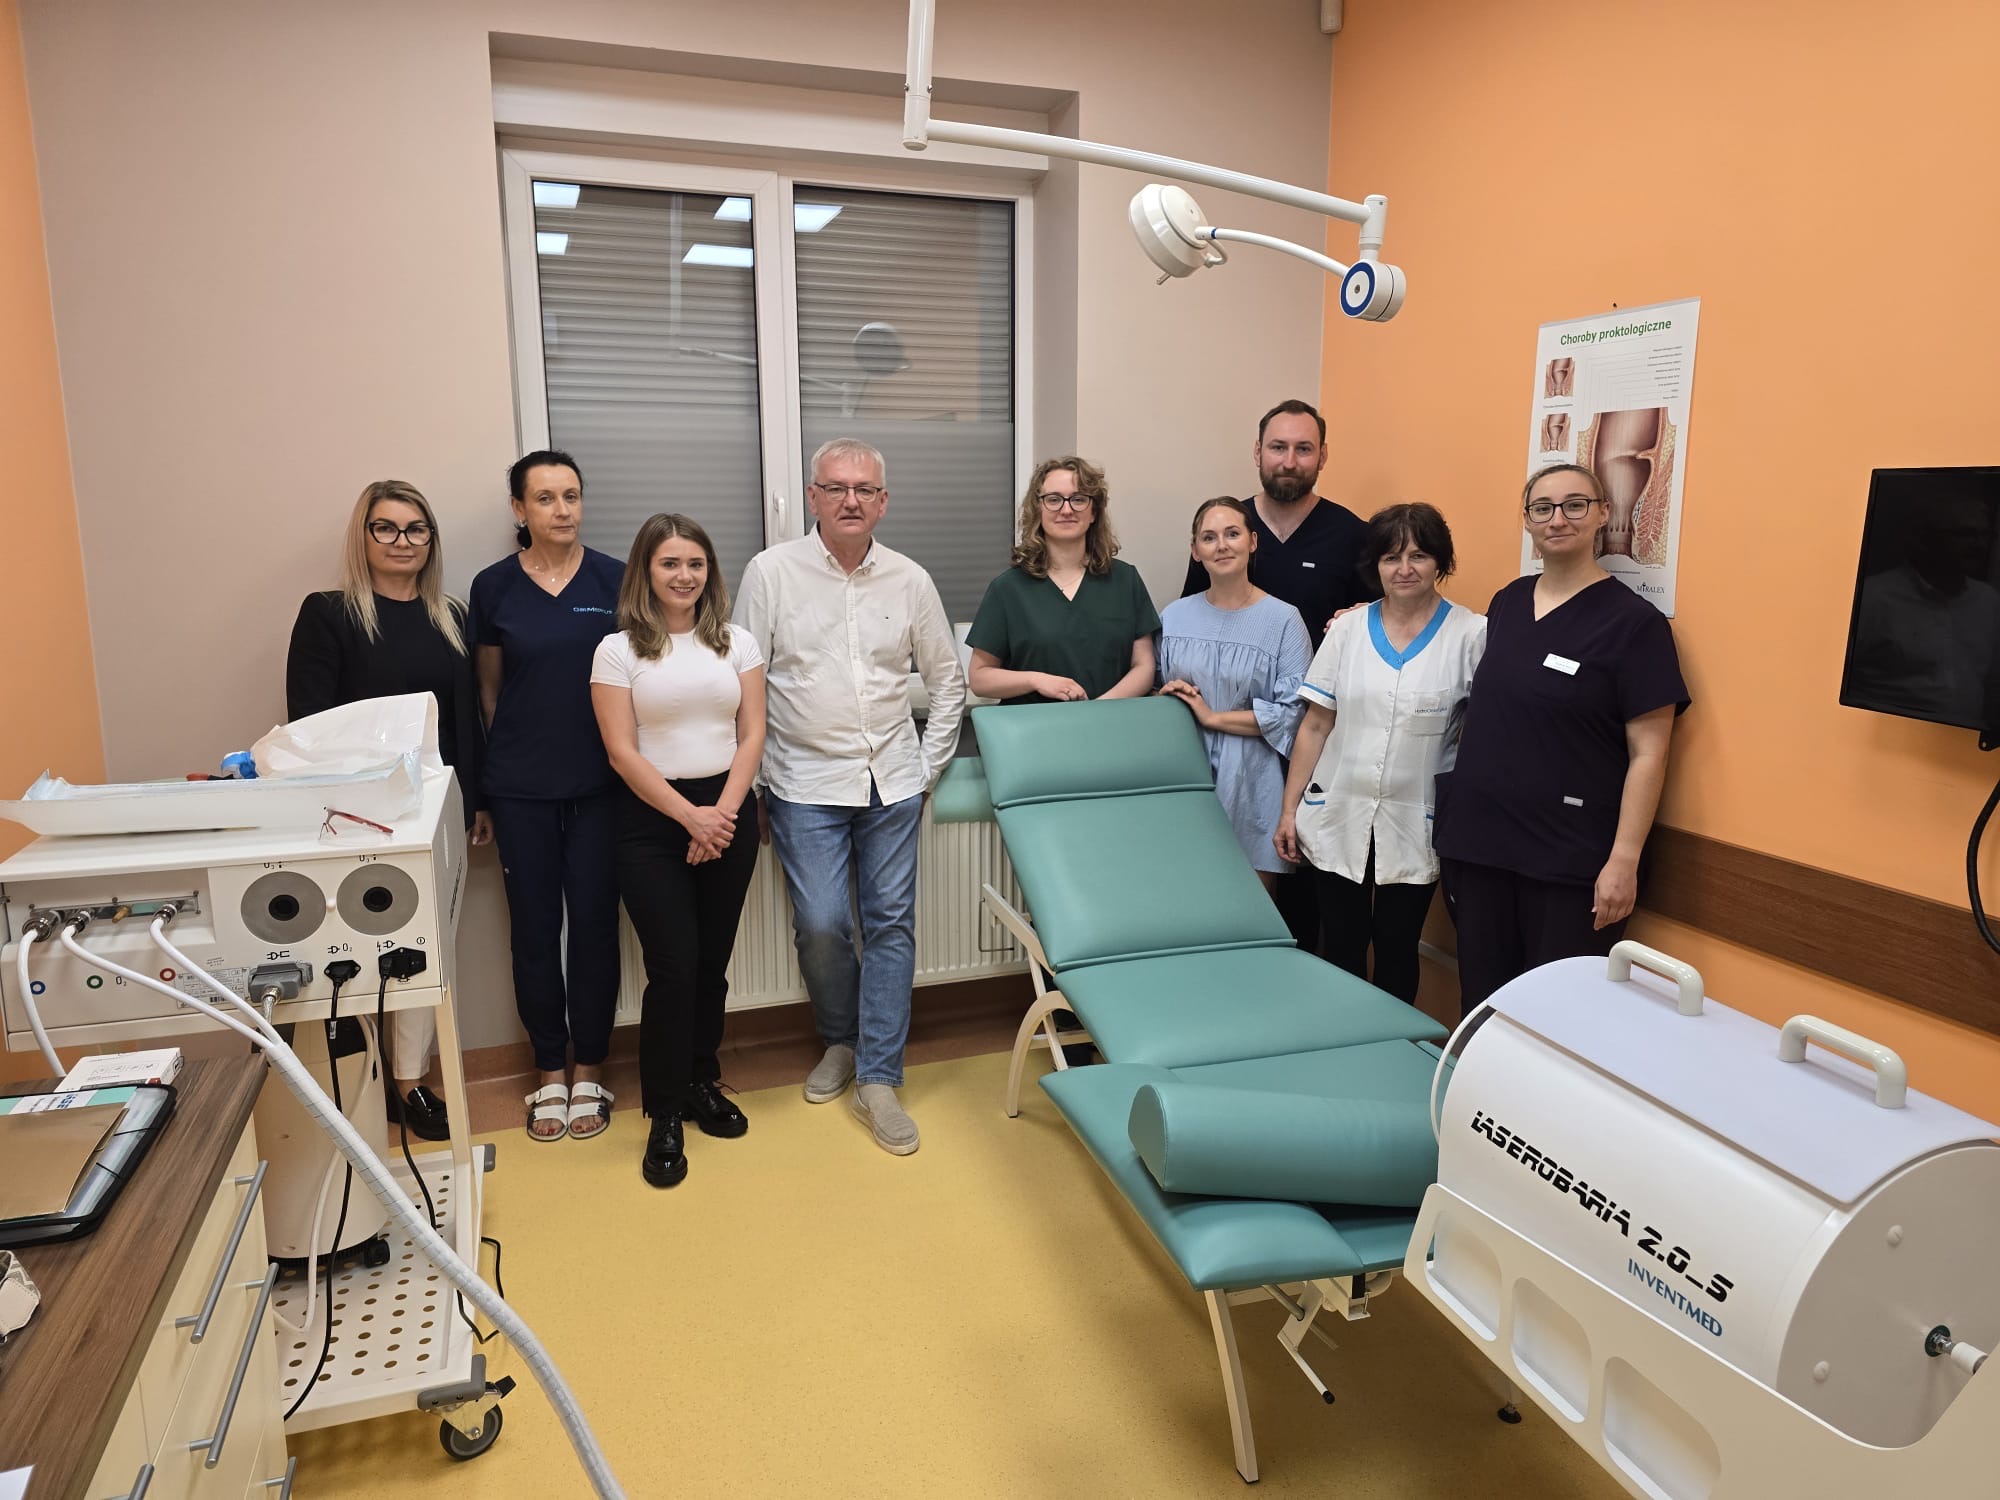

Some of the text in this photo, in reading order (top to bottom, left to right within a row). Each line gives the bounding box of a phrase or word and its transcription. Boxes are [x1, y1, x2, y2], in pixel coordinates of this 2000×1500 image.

[1560, 320, 1672, 346] Choroby proktologiczne
[1628, 1258, 1723, 1337] INVENTMED
